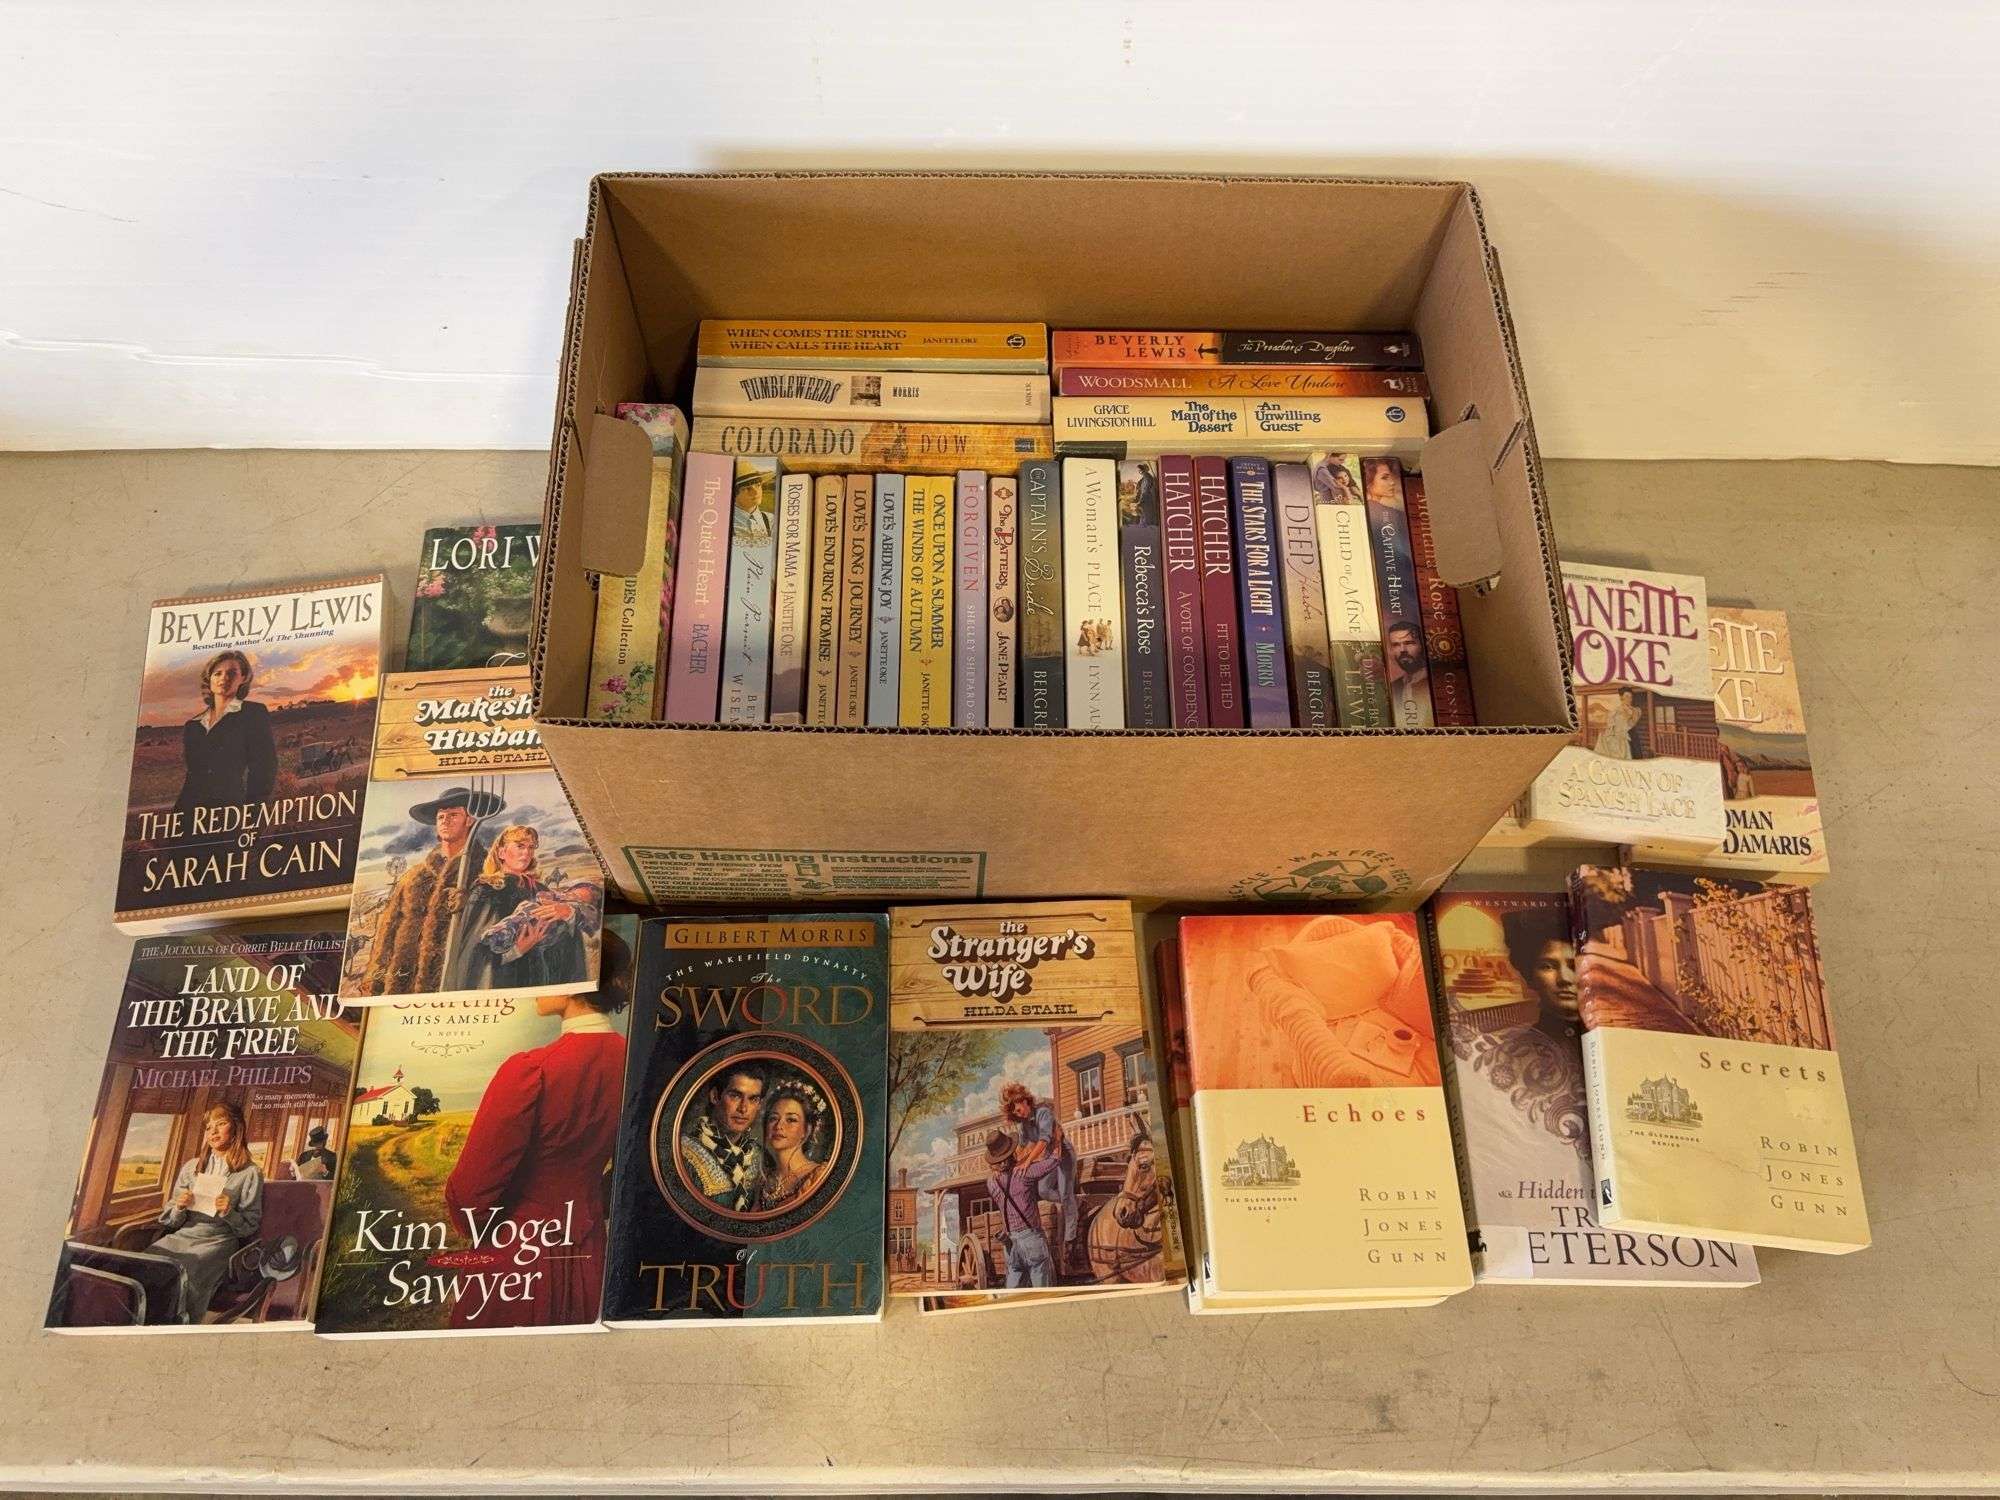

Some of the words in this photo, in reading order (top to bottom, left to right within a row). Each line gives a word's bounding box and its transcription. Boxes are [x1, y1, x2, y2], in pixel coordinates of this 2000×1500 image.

[726, 328, 769, 339] WHEN
[772, 329, 820, 339] COMES
[822, 329, 849, 340] THE
[851, 329, 907, 340] SPRING
[730, 341, 772, 351] WHEN
[776, 341, 820, 351] CALLS
[822, 341, 851, 351] THE
[853, 341, 902, 352] HEART
[1094, 335, 1185, 346] BEVERLY
[1302, 340, 1356, 360] Daughter
[1126, 347, 1187, 358] LEWIS
[739, 375, 841, 405] TUMBLEWEEDS
[892, 386, 920, 398] MORRIS
[1078, 375, 1192, 389] WOODSMALL
[1240, 374, 1281, 391] Love
[1067, 416, 1128, 428] LIVINGSTON
[1130, 417, 1156, 427] HILL
[1093, 404, 1130, 415] GRACE
[1171, 410, 1200, 421] Man
[1185, 401, 1209, 412] The
[1254, 410, 1321, 423] Unwilling
[1258, 401, 1281, 411] An
[720, 424, 855, 456] COLORADO
[1188, 421, 1233, 433] Desert
[1260, 421, 1303, 432] Guest
[703, 477, 720, 505] The
[786, 482, 802, 520] ROSES
[911, 488, 926, 515] THE
[1240, 481, 1265, 505] THE
[824, 494, 838, 533] LOVE'S
[851, 489, 867, 532] LOVE'S
[881, 492, 895, 531] LOVE'S
[932, 494, 946, 530] ONCE
[999, 504, 1013, 527] The
[1029, 467, 1047, 553] CAPTAIN'S
[1083, 478, 1102, 554] Woman's
[1164, 471, 1196, 573] HATCHER
[1200, 475, 1232, 577] HATCHER
[1242, 505, 1270, 543] STARS
[698, 511, 719, 553] Quiet
[785, 520, 800, 543] FOR
[911, 518, 925, 563] WINDS
[962, 484, 980, 593] FORGIVEN
[1284, 504, 1315, 567] DEEP
[1335, 510, 1353, 561] CHILD
[1380, 523, 1398, 572] CAPTIVE
[430, 535, 513, 572] LORI
[784, 543, 800, 578] MAMA
[820, 536, 835, 601] ENDURING
[850, 537, 865, 575] LONG
[880, 533, 894, 587] ABIDING
[932, 533, 945, 574] UPON
[993, 526, 1014, 590] PATTERN
[1244, 543, 1270, 567] FOR
[695, 559, 715, 604] Heart
[742, 551, 763, 594] Plain
[910, 566, 923, 584] OF
[1023, 552, 1056, 616] Bride
[1086, 561, 1102, 613] PLACE
[1134, 545, 1156, 616] Rebecca's
[1247, 568, 1271, 577] A
[879, 587, 893, 610] JOY
[1176, 591, 1193, 602] A
[1248, 579, 1274, 617] LIGHT
[1338, 576, 1364, 634] MINE
[1387, 573, 1403, 616] HEART
[158, 603, 281, 645] BEVERLY
[290, 592, 373, 632] LEWIS
[780, 590, 796, 633] JANETTE
[848, 579, 863, 644] JOURNEY
[908, 588, 923, 653] AUTUMN
[930, 588, 945, 649] SUMMER
[966, 604, 976, 651] SHELLEY
[1178, 601, 1193, 633] VOTE
[192, 638, 233, 651] Bestselling
[235, 637, 261, 648] Author
[276, 633, 292, 643] The
[293, 629, 335, 642] Shunning
[780, 634, 794, 656] OKE
[818, 605, 833, 662] PROMISE
[879, 630, 889, 663] JANETTE
[996, 630, 1010, 661] JANE
[1136, 618, 1155, 655] Rose
[1181, 635, 1194, 652] OF
[1216, 622, 1229, 642] FIT
[689, 623, 710, 675] BACHER
[1217, 644, 1230, 660] TO
[1255, 641, 1276, 688] MORRIS
[1573, 629, 1674, 687] OKE
[848, 665, 858, 700] JANETTE
[965, 656, 976, 709] SHEPARD
[996, 662, 1008, 704] PEART
[1088, 664, 1101, 702] LYNN
[1219, 663, 1232, 679] BE
[488, 685, 513, 698] the
[816, 684, 827, 719] JANETTE
[1220, 680, 1234, 709] TIED
[847, 700, 857, 719] OKE
[438, 755, 489, 767] HILDA
[493, 752, 547, 763] STAHL
[1588, 759, 1647, 787] GOWN
[139, 809, 185, 842] THE
[192, 789, 358, 836] REDEMPTION
[238, 830, 258, 848] OF
[1723, 828, 1812, 856] DAMARIS
[143, 851, 250, 893] SARAH
[259, 838, 343, 878] CAIN
[634, 849, 694, 860] Safe
[700, 852, 815, 864] Handling
[822, 854, 974, 865] Instructions
[1474, 900, 1547, 908] WESTWARD
[674, 928, 771, 944] GILBERT
[779, 927, 868, 942] MORRIS
[1000, 920, 1025, 934] the
[160, 944, 214, 957] JOURNALS
[230, 942, 268, 955] CORRIE
[269, 941, 302, 953] BELLE
[928, 924, 1092, 963] Stranger's
[178, 964, 260, 996] LAND
[266, 963, 306, 991] OF
[666, 965, 694, 981] THE
[704, 953, 792, 968] WAKEFIELD
[802, 955, 868, 980] DYNASTY
[942, 962, 1028, 999] Wife
[127, 999, 186, 1029] THE
[184, 995, 282, 1028] BRAVE
[284, 992, 345, 1021] AND
[401, 1015, 441, 1025] MISS
[446, 1014, 500, 1025] AMSEL
[654, 984, 874, 1032] SWORD
[964, 1004, 1018, 1018] HILDA
[1021, 1003, 1078, 1016] STAHL
[160, 1029, 219, 1058] THE
[220, 1026, 301, 1060] FREE
[132, 1067, 221, 1090] MICHAEL
[225, 1065, 313, 1087] PHILLIPS
[1699, 1051, 1827, 1083] Secrets
[1302, 1103, 1426, 1123] Echoes
[1759, 1135, 1839, 1157] ROBIN
[1517, 1180, 1586, 1199] Hidden
[1766, 1164, 1845, 1188] JONES
[1359, 1187, 1438, 1202] ROBIN
[1769, 1194, 1849, 1218] GUNN
[349, 1209, 449, 1253] Kim
[460, 1200, 574, 1265] Vogel
[1362, 1219, 1443, 1236] JONES
[1367, 1249, 1448, 1264] GUNN
[383, 1261, 543, 1320] Sawyer
[638, 1261, 867, 1312] TRUTH
